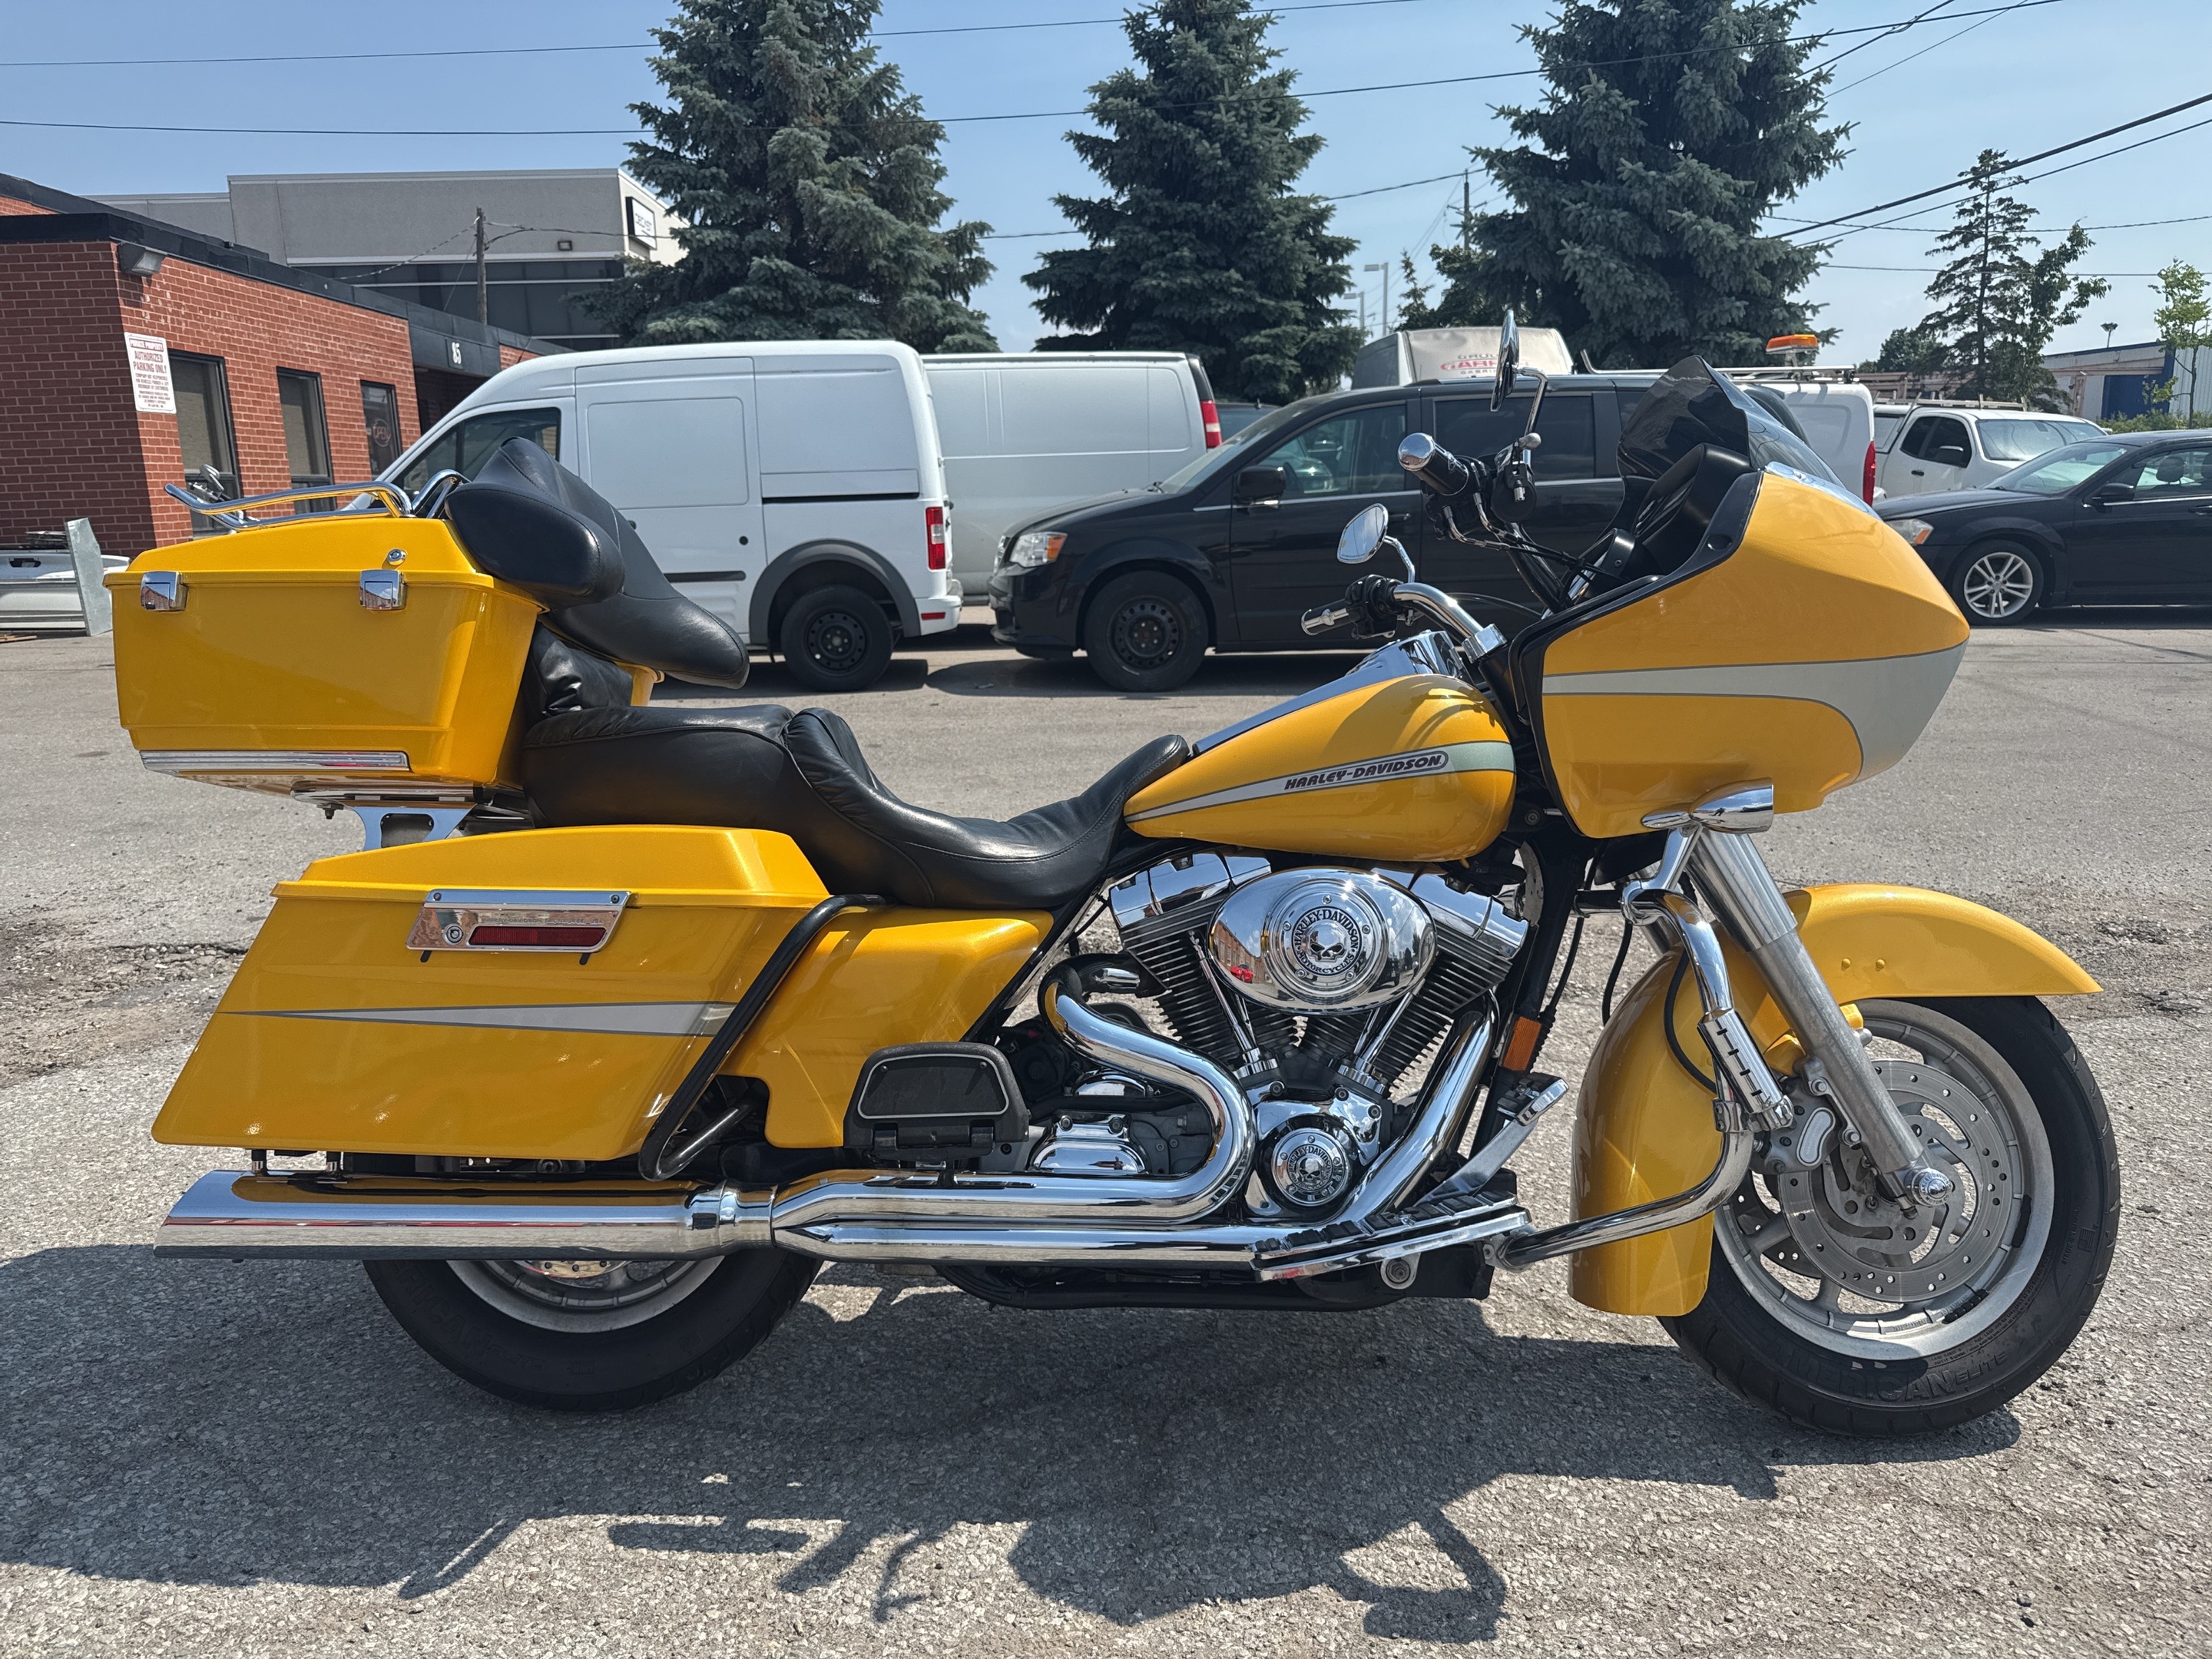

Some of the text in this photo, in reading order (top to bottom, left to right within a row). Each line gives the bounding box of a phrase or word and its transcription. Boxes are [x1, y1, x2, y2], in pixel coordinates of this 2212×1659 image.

[133, 361, 154, 373] PARKING
[1284, 755, 1442, 790] HARLEY-DAVIDSON
[1293, 909, 1359, 949] HARLEY-DAVIDSON
[1297, 952, 1355, 974] MOTORCYCLES
[1955, 1352, 2008, 1383] ELITE
